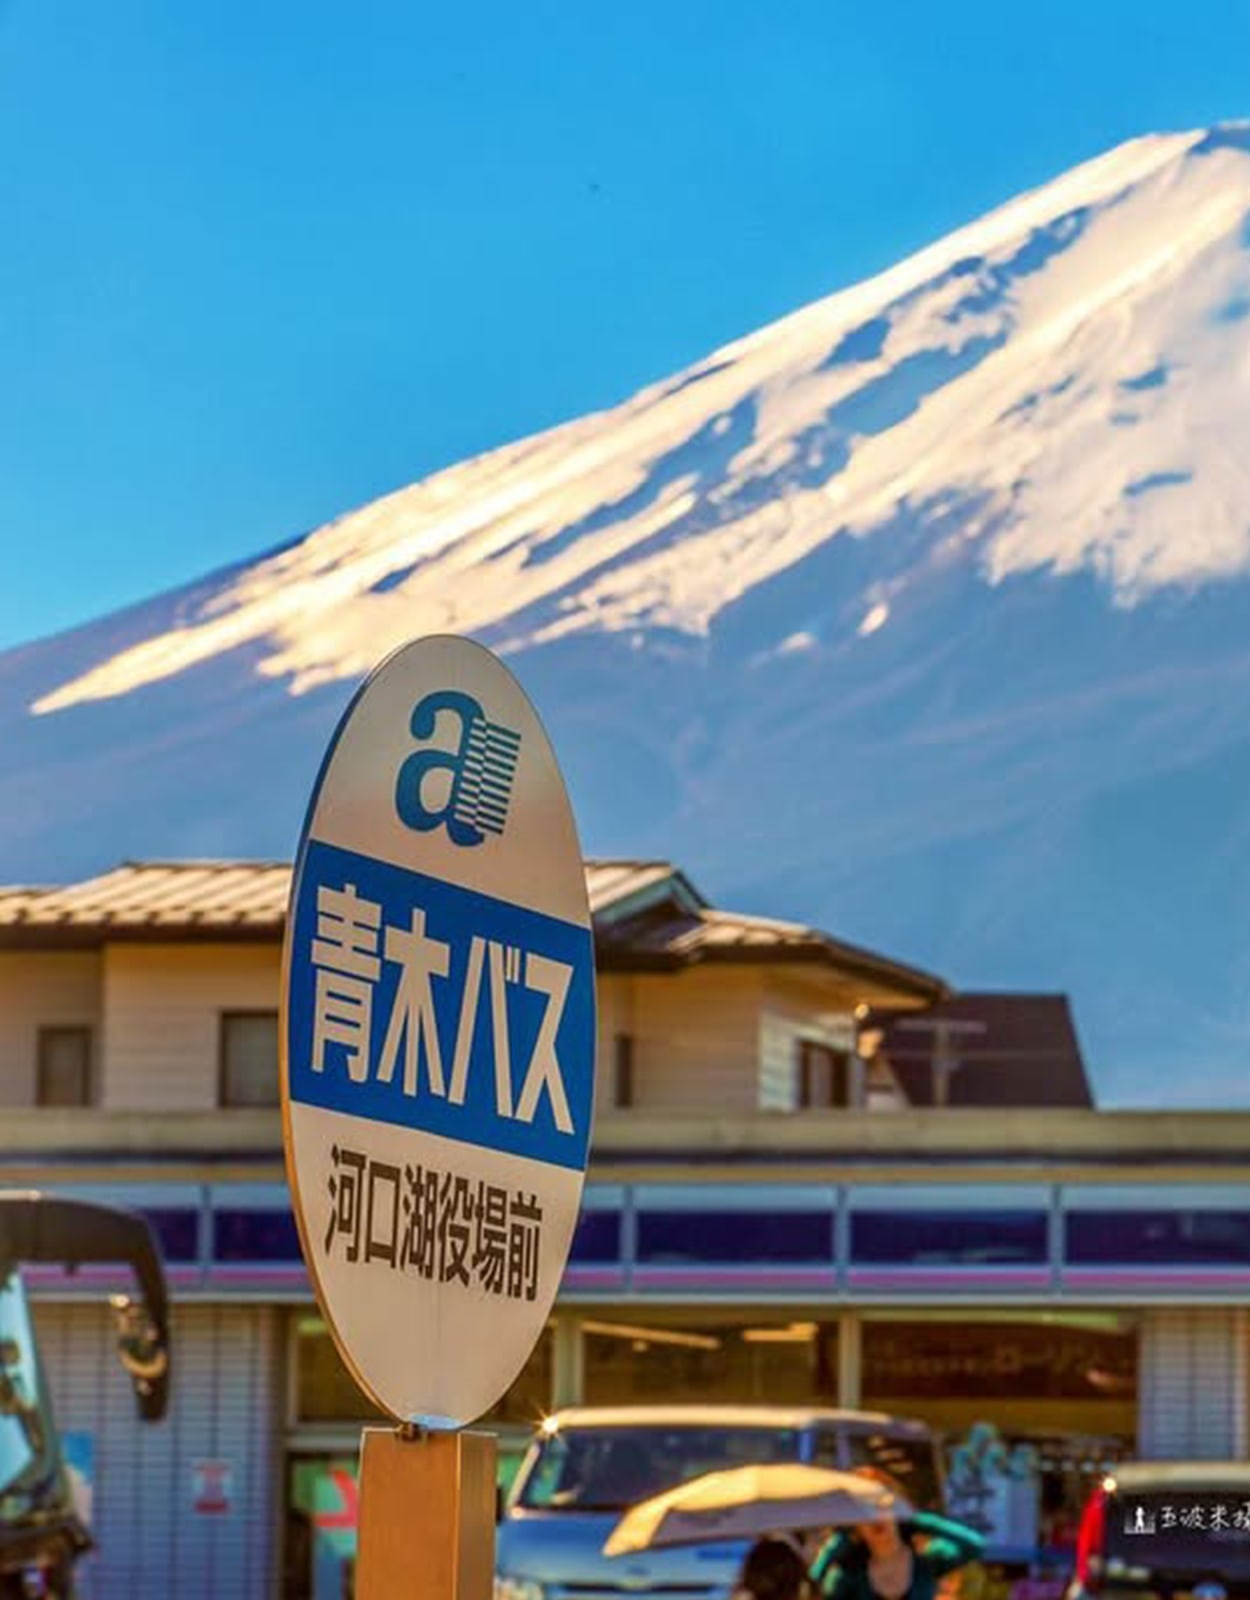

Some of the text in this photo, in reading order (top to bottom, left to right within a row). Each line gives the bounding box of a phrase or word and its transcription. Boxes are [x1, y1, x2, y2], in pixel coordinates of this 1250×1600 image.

[311, 884, 576, 1135] 青木バス
[324, 1143, 543, 1301] 河口湖役場前
